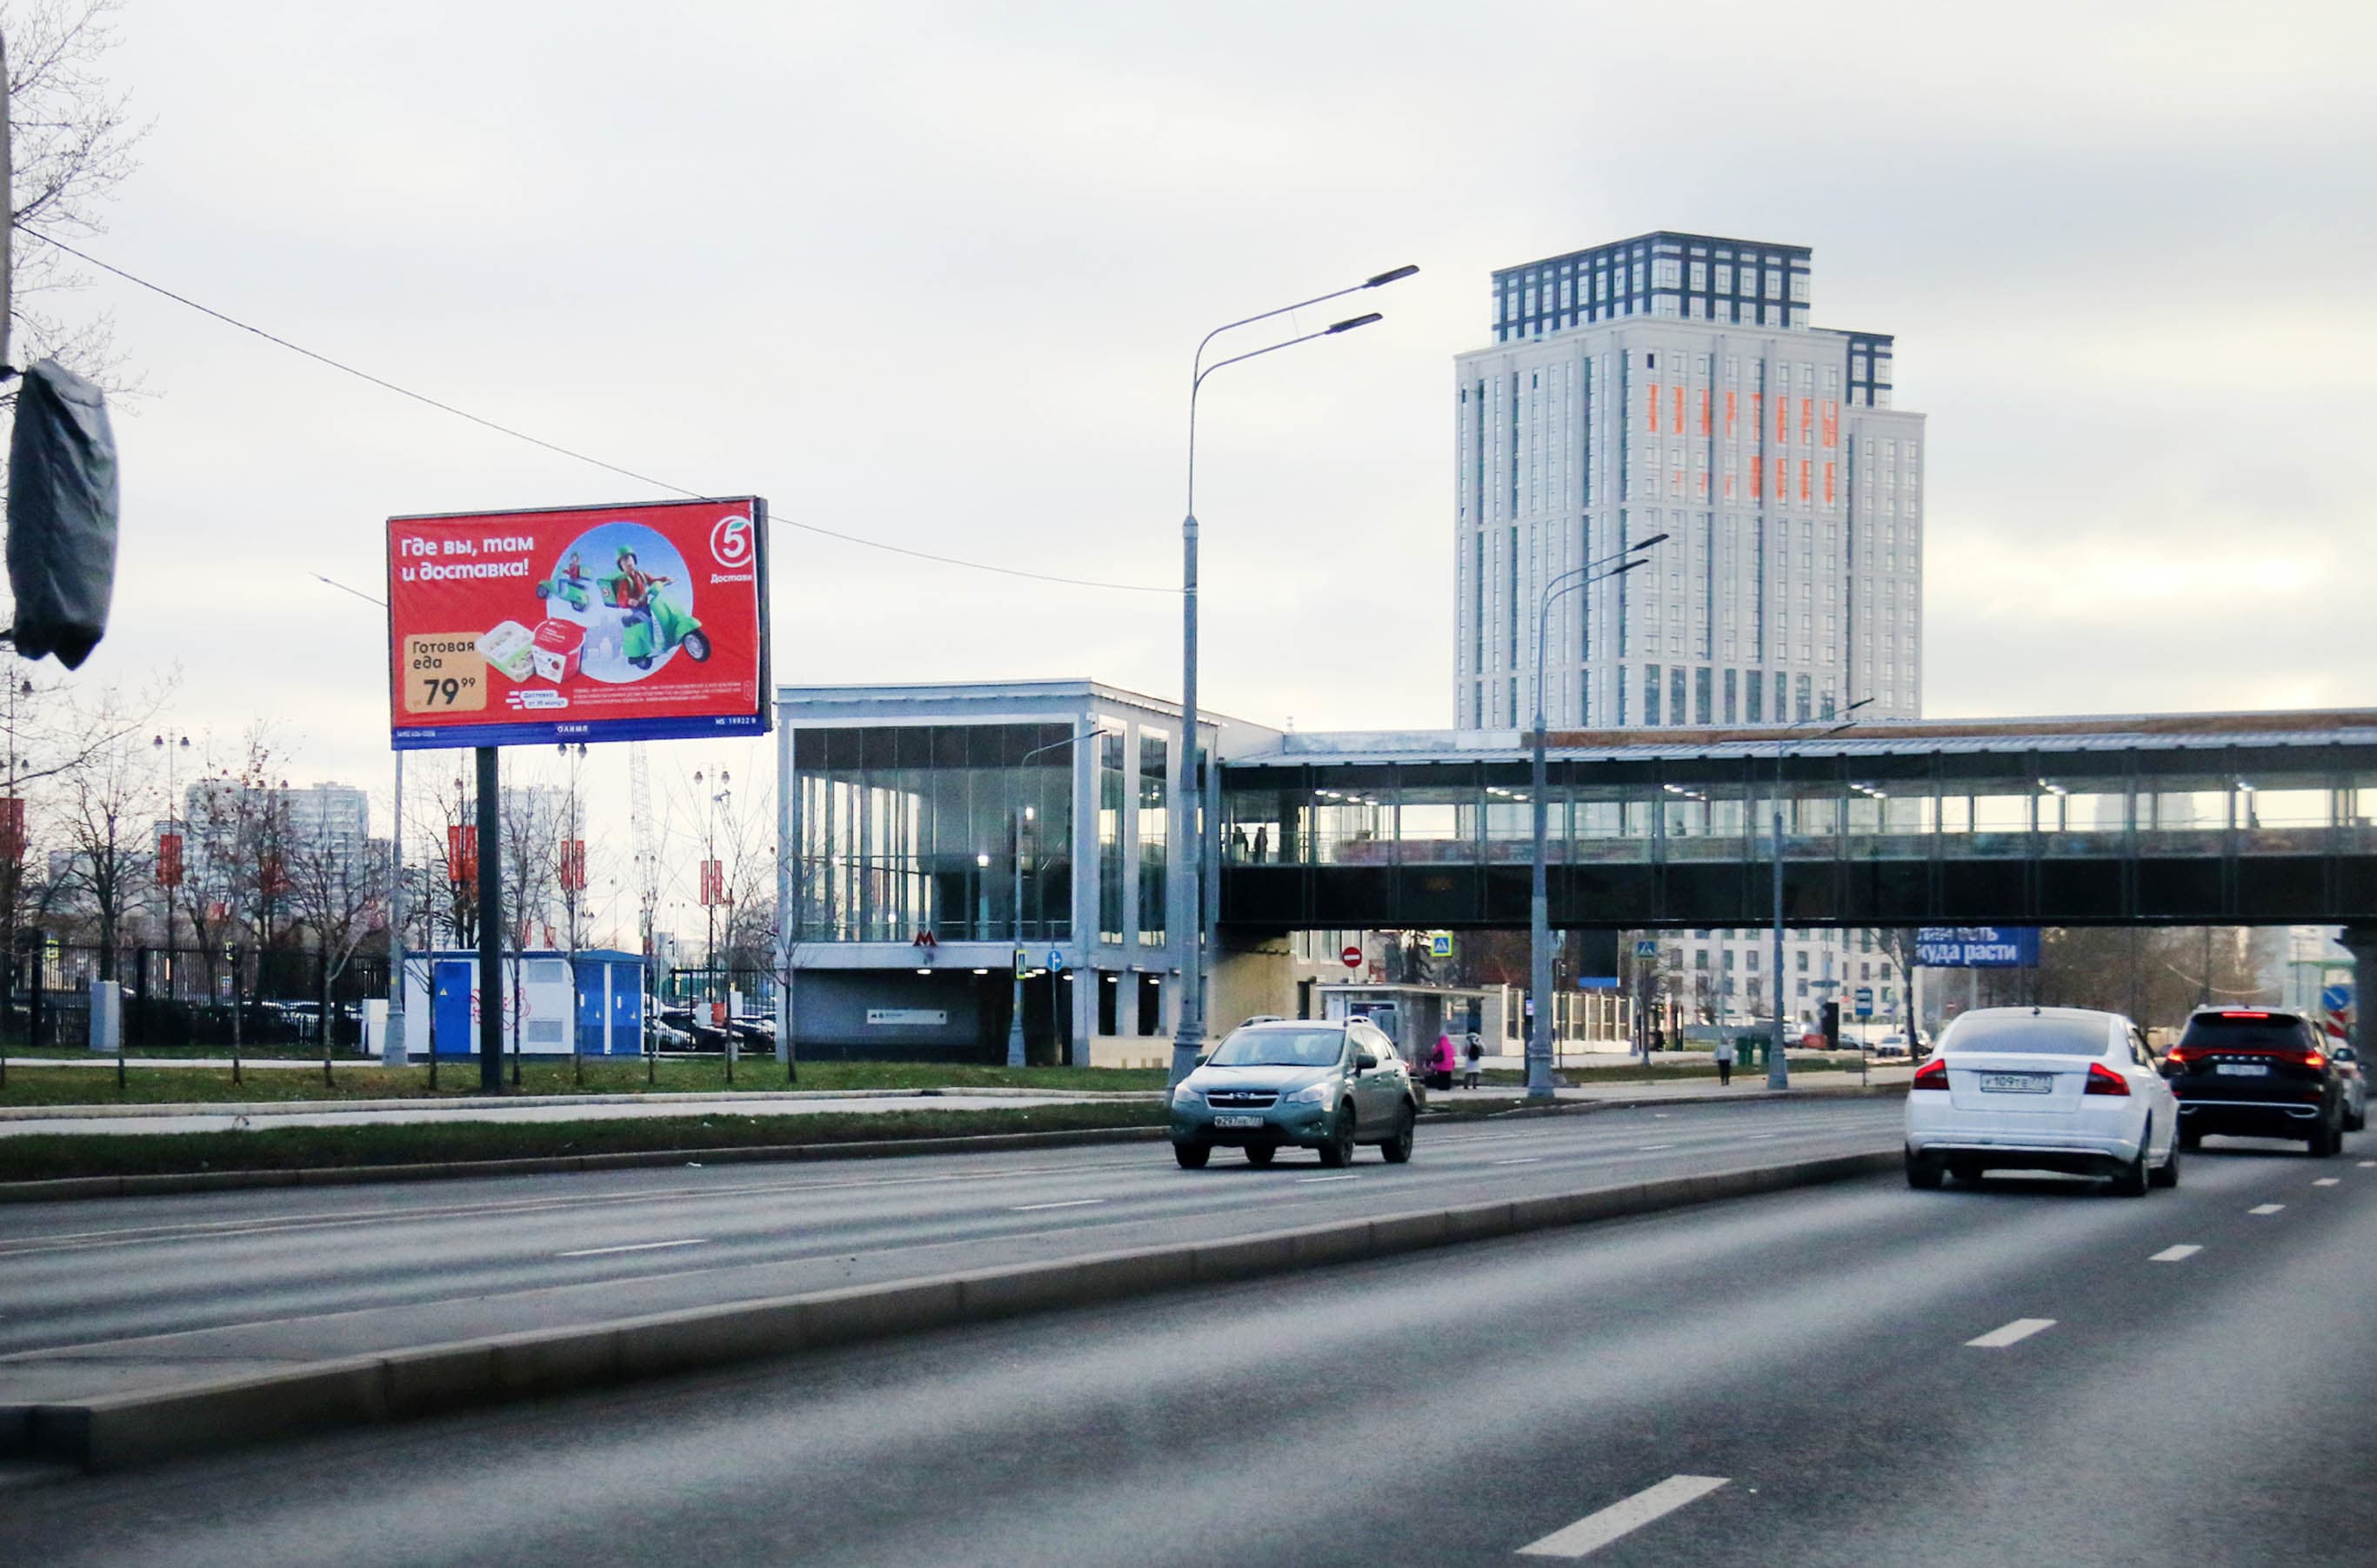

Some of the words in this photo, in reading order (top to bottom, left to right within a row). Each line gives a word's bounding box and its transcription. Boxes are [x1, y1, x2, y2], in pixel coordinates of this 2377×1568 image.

[402, 537, 437, 557] Где
[444, 540, 477, 557] вы,
[483, 537, 534, 553] там
[402, 567, 415, 581] и
[419, 558, 529, 580] доставка!
[413, 641, 475, 654] Готовая
[413, 656, 442, 669] еда
[1964, 944, 2017, 965] расти
